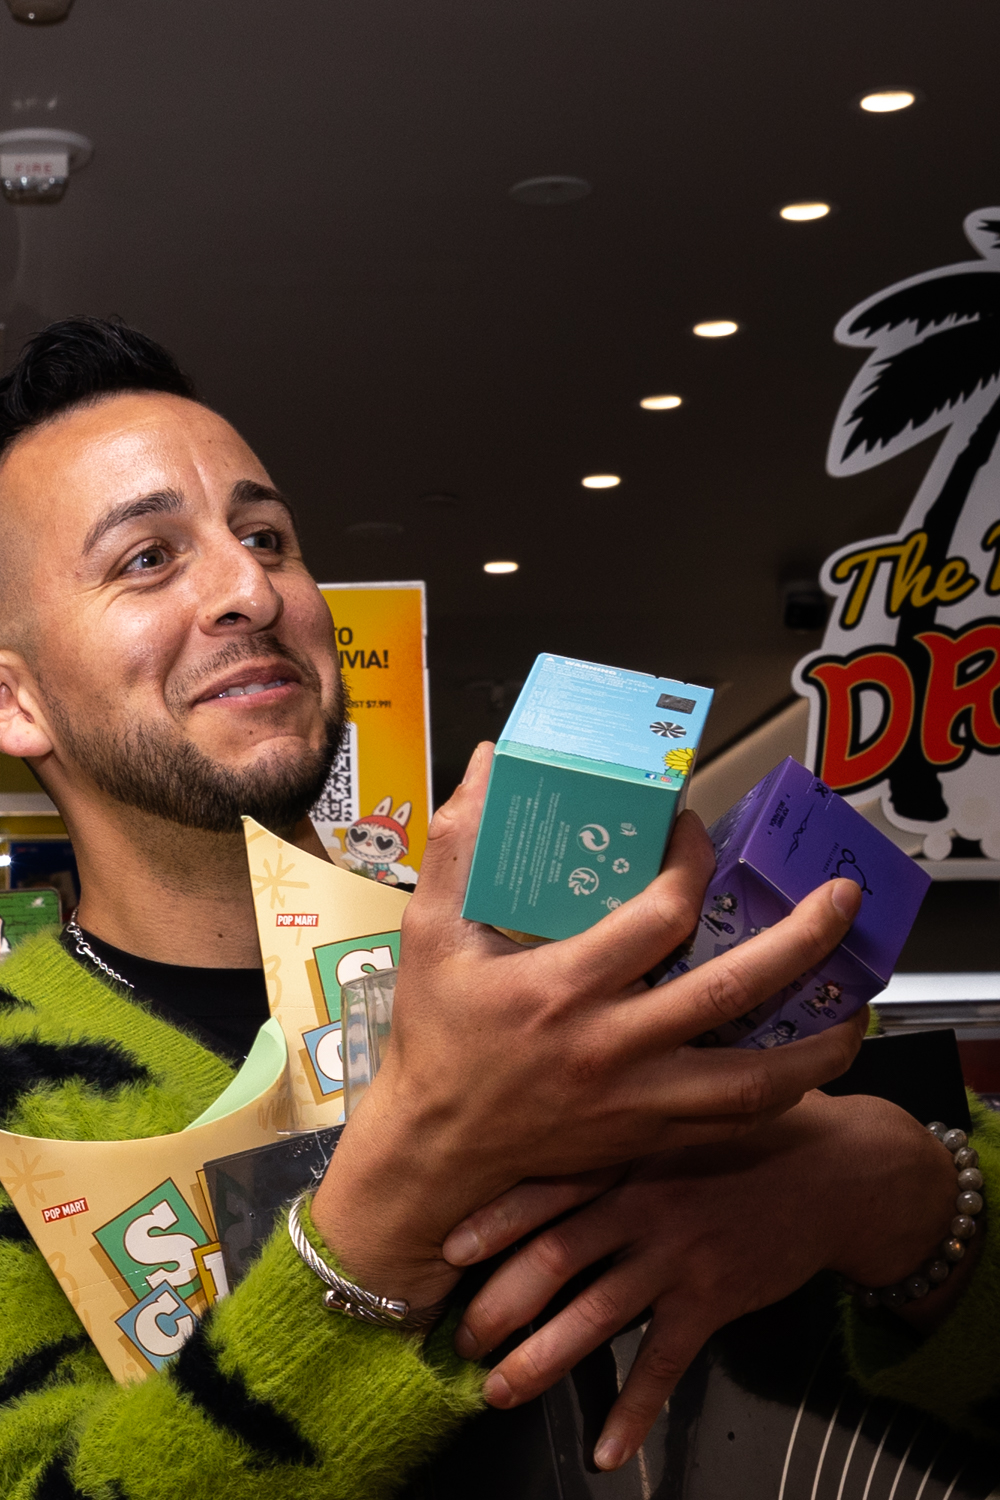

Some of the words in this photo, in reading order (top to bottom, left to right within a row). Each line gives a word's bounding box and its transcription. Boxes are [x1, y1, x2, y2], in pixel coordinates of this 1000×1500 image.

[834, 530, 976, 633] The
[335, 626, 353, 646] O
[339, 649, 389, 669] IVIA!
[277, 914, 294, 926] POP
[294, 914, 318, 926] MART
[43, 1206, 65, 1222] POP
[65, 1198, 87, 1217] MART
